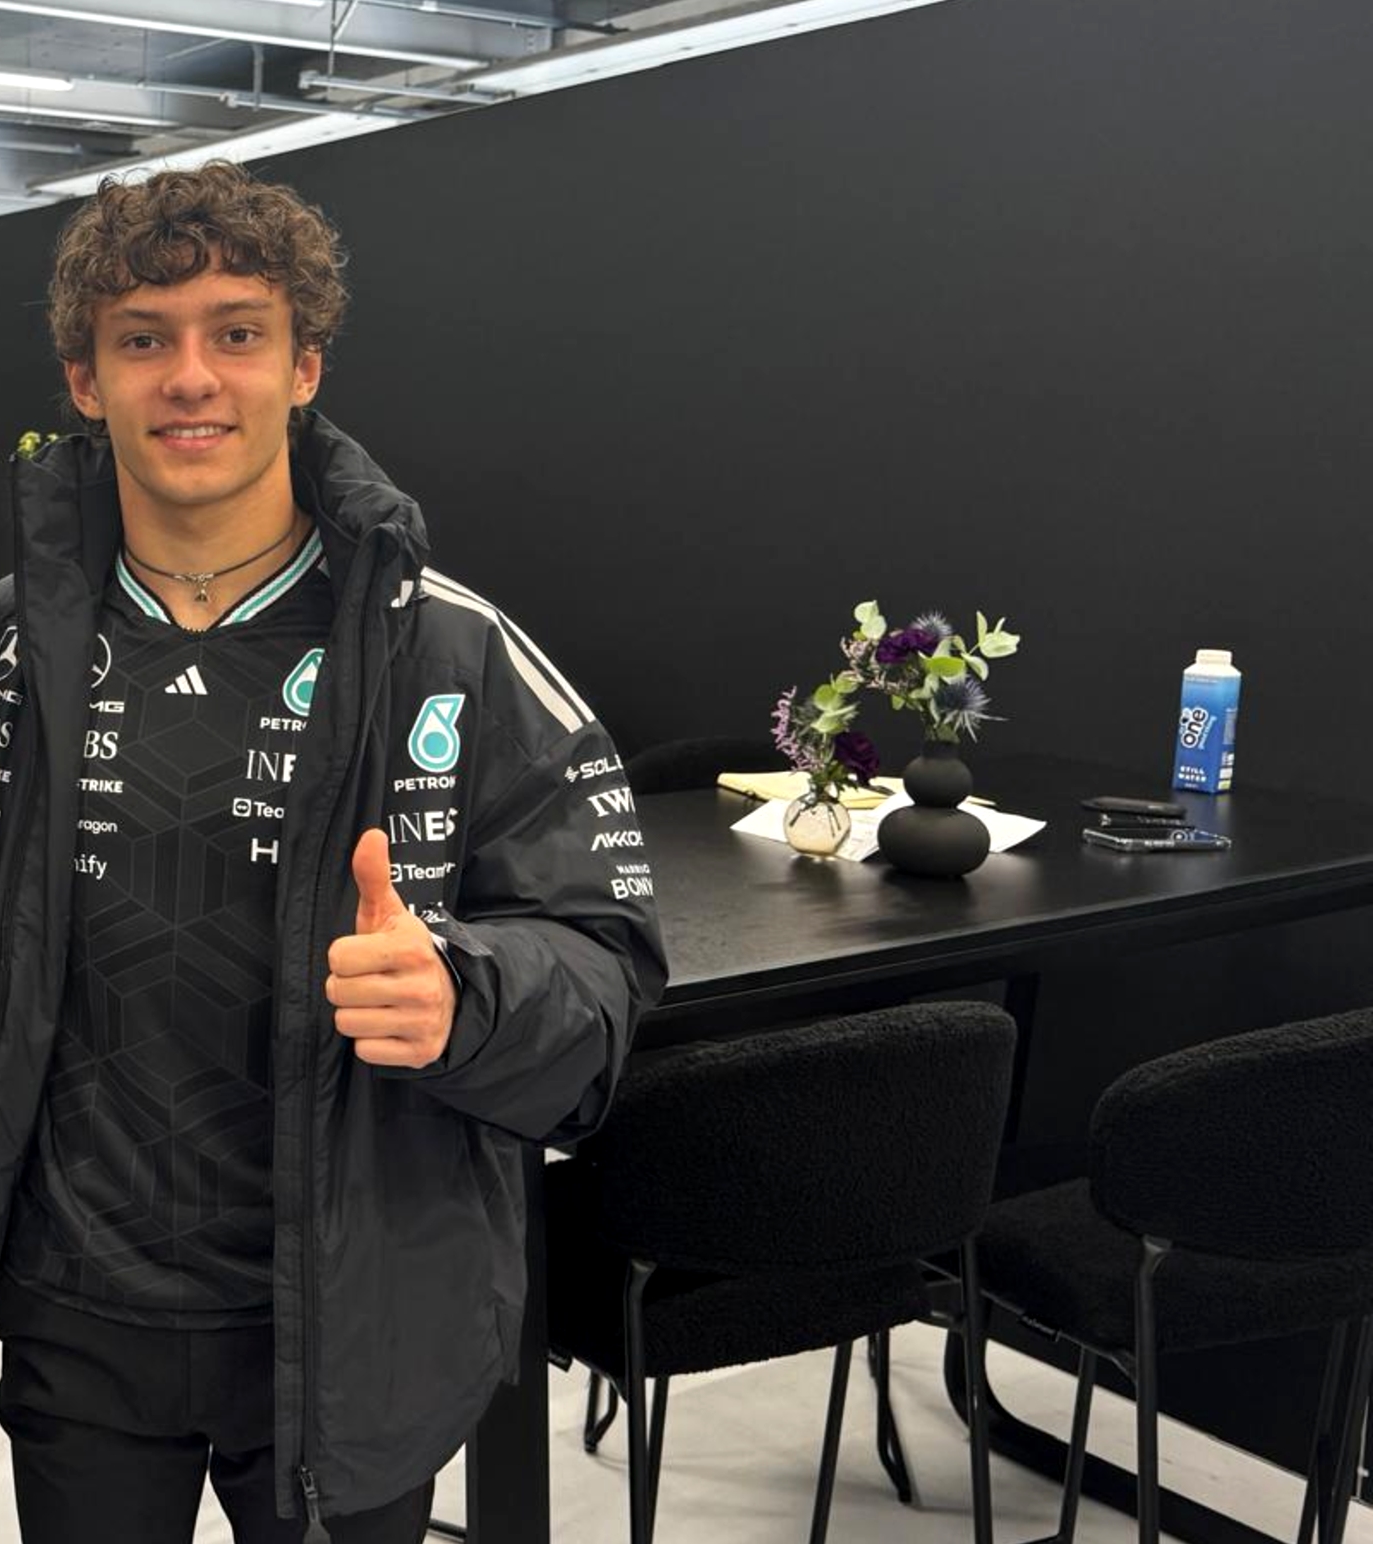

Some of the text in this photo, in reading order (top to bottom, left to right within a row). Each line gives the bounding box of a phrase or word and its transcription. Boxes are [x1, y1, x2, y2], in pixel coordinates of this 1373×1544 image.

[1181, 708, 1208, 748] one
[84, 730, 118, 760] BS
[76, 778, 124, 793] TRIKE
[587, 787, 636, 817] IW
[591, 830, 644, 851] AKKO
